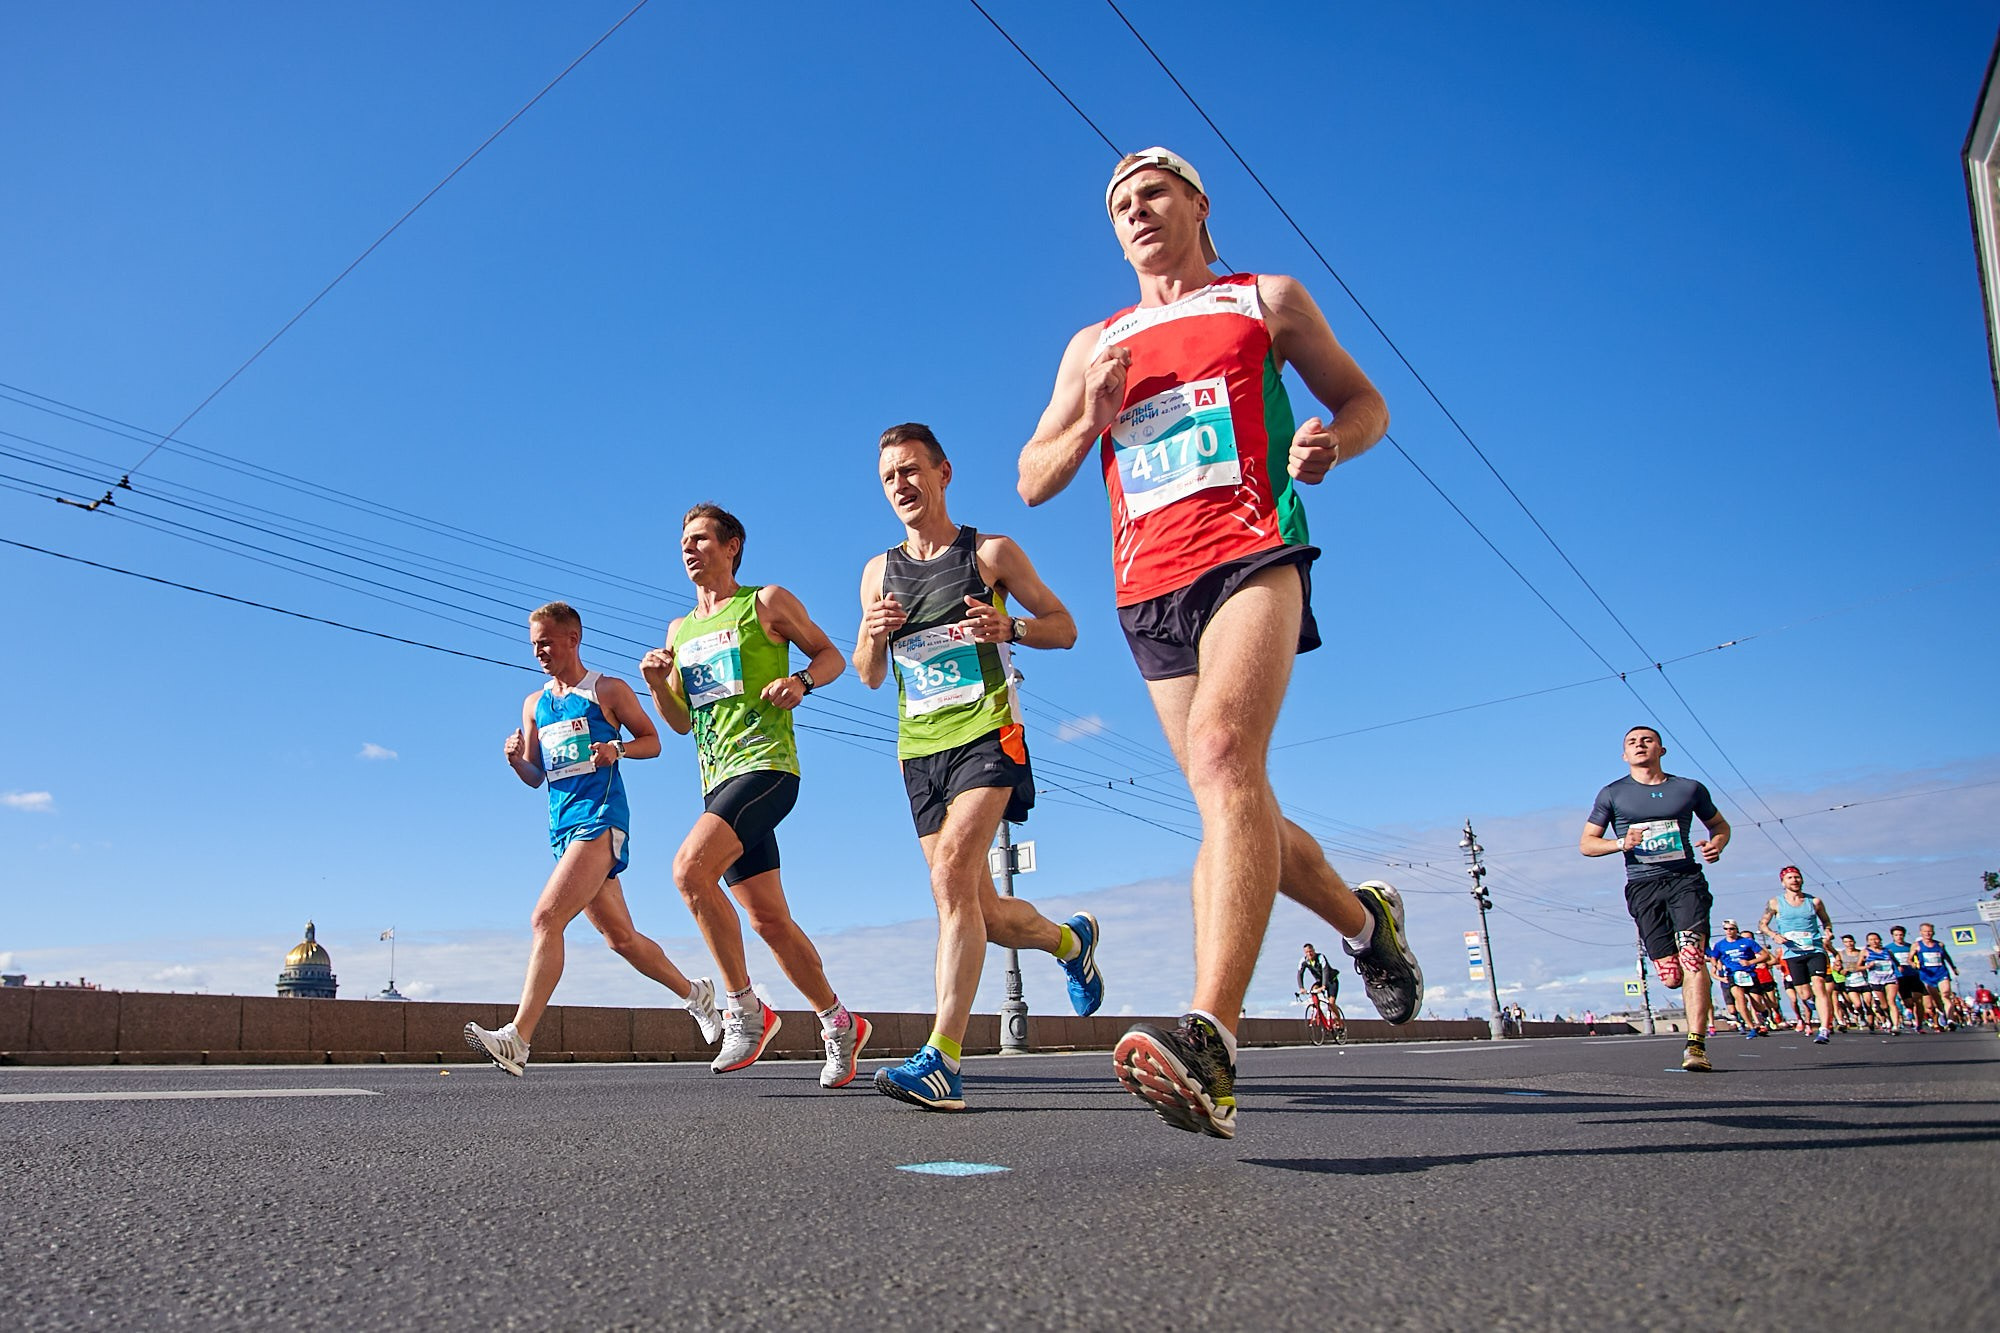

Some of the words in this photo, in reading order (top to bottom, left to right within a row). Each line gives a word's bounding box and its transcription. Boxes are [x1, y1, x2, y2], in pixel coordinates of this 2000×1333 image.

[1120, 402, 1154, 424] БЕЛЫЕ
[1131, 408, 1159, 427] НОЧИ
[1131, 425, 1219, 480] 4170
[692, 660, 725, 687] 331
[913, 660, 961, 691] 353
[549, 743, 580, 764] 378
[1640, 836, 1675, 852] 1091
